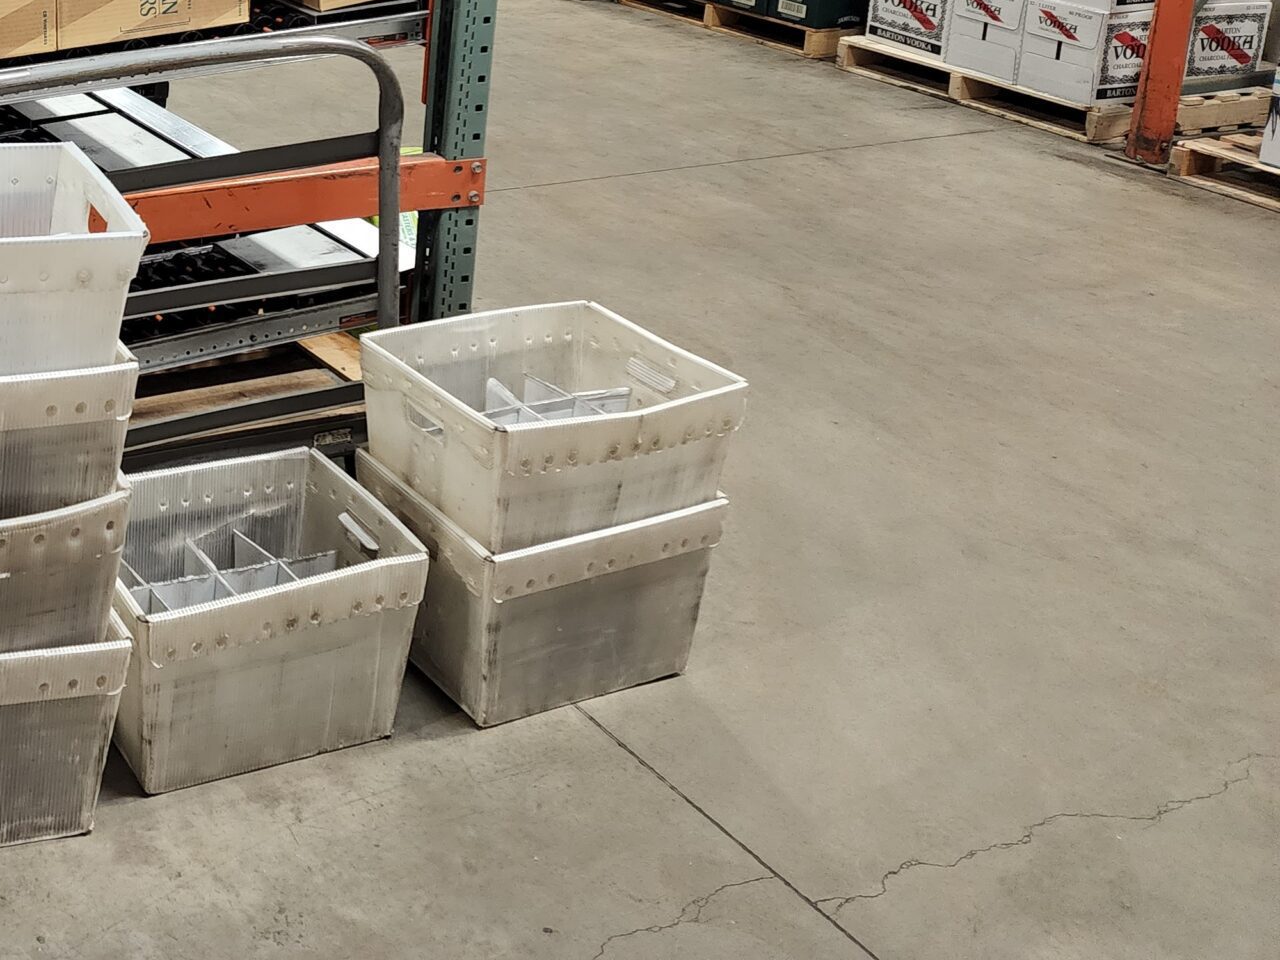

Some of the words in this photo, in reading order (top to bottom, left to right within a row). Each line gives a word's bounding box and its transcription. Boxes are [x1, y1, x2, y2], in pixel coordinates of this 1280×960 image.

[877, 28, 905, 45] BARTON
[906, 35, 932, 53] VODKA
[1199, 34, 1254, 53] VODKA
[1113, 43, 1146, 60] VOD
[1106, 86, 1136, 97] BARTON
